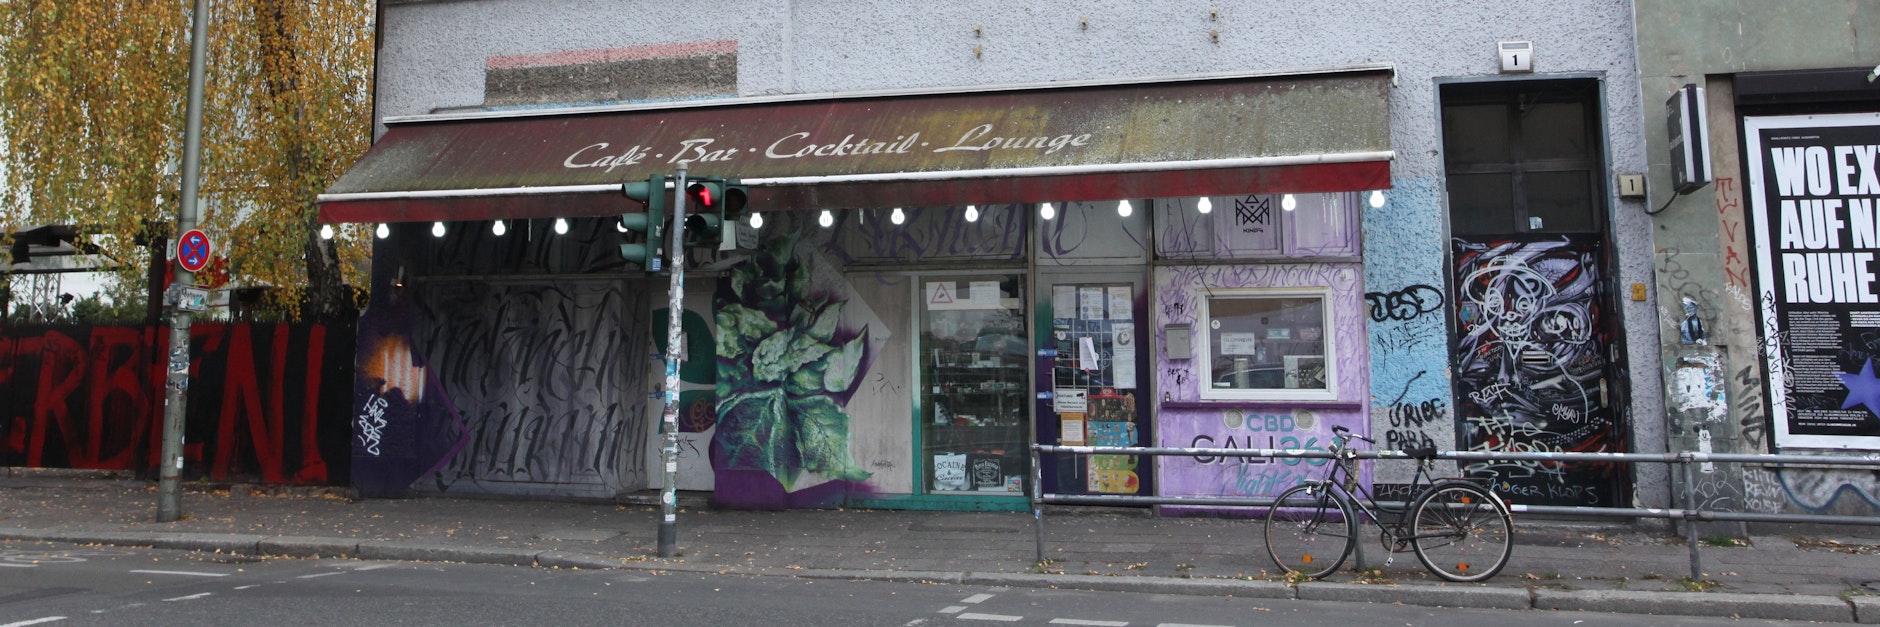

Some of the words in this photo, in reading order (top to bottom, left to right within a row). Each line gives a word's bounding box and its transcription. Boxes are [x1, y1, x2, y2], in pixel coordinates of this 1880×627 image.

[1511, 54, 1519, 66] 1
[563, 142, 653, 173] Café
[667, 138, 739, 164] Bar
[765, 131, 920, 159] Cocktail
[933, 123, 1092, 155] Lounge
[1771, 146, 1832, 196] WO
[1834, 144, 1880, 196] EX
[1629, 178, 1635, 192] 1
[1780, 199, 1845, 249] AUF
[1848, 198, 1880, 249] N
[1782, 252, 1879, 304] RUHE
[1246, 413, 1296, 432] CBD
